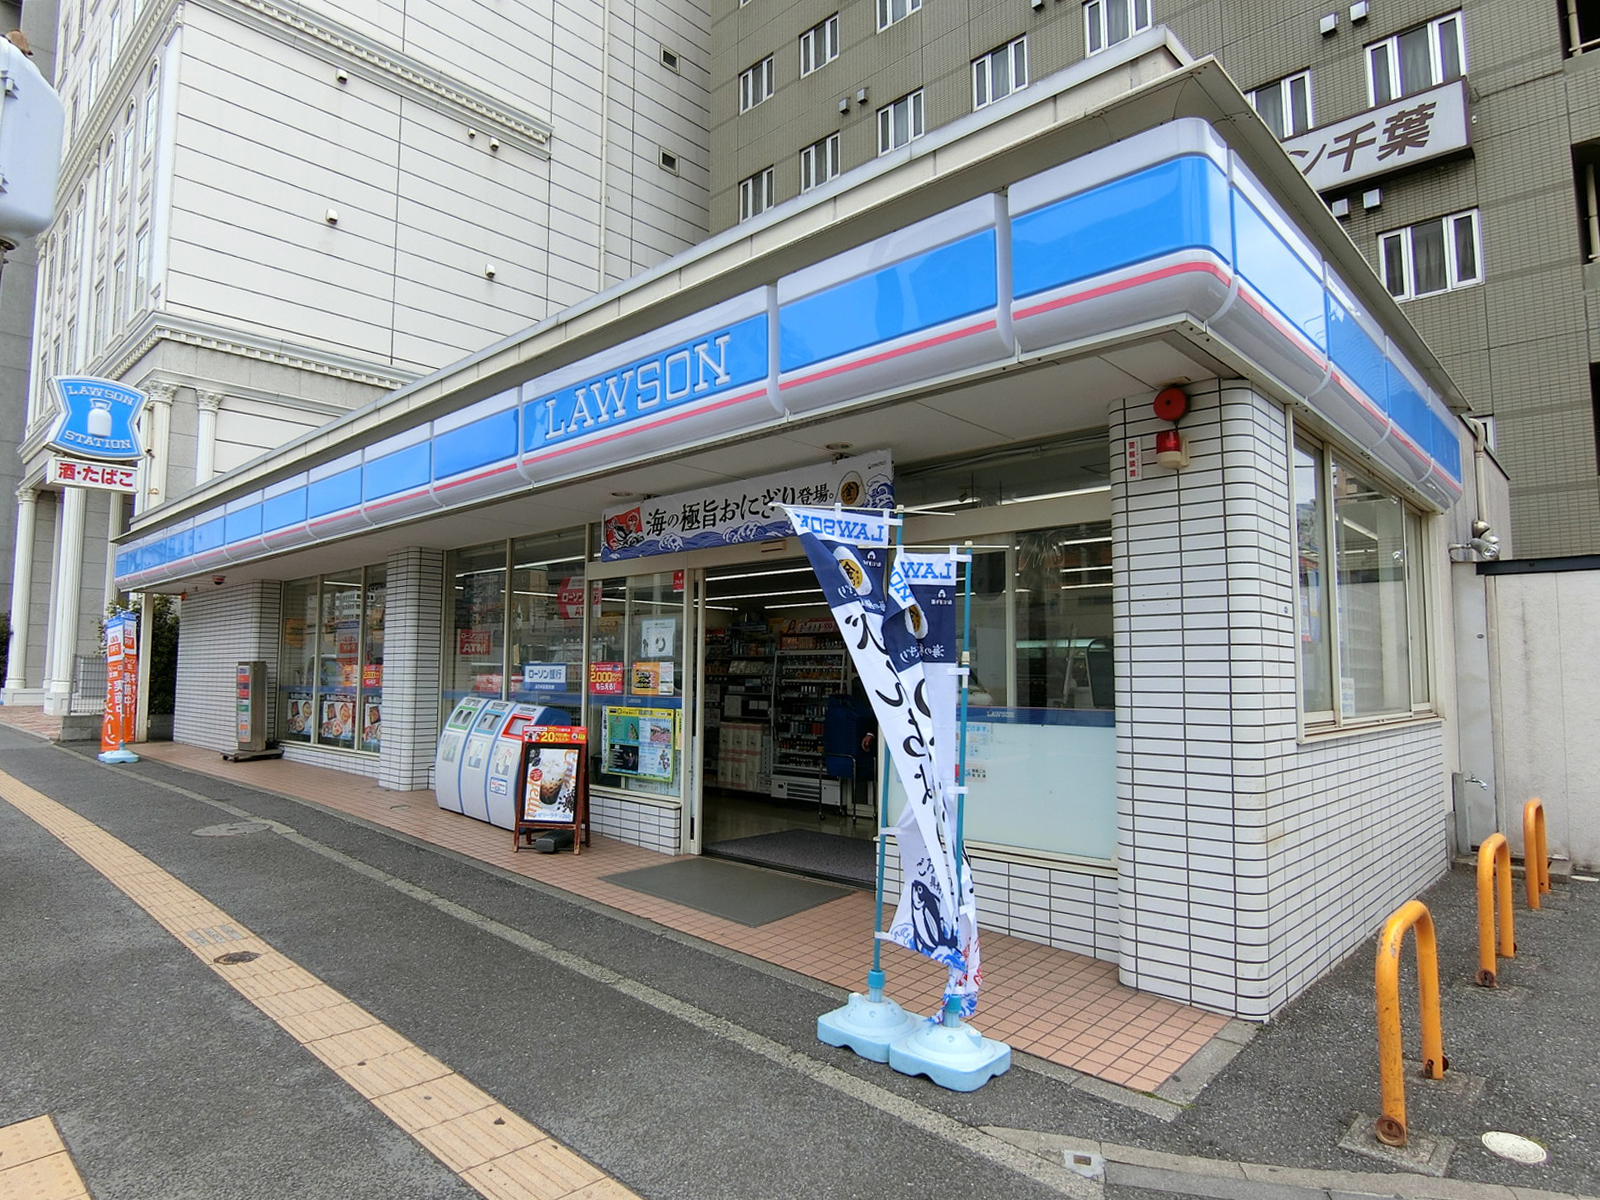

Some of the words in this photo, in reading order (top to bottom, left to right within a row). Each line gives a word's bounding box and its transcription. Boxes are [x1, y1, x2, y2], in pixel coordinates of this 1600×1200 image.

[66, 385, 135, 406] LAWSON
[545, 333, 731, 440] LAWSON
[64, 430, 132, 449] STATION
[58, 462, 133, 487] 酒・たばこ
[541, 732, 555, 742] 20
